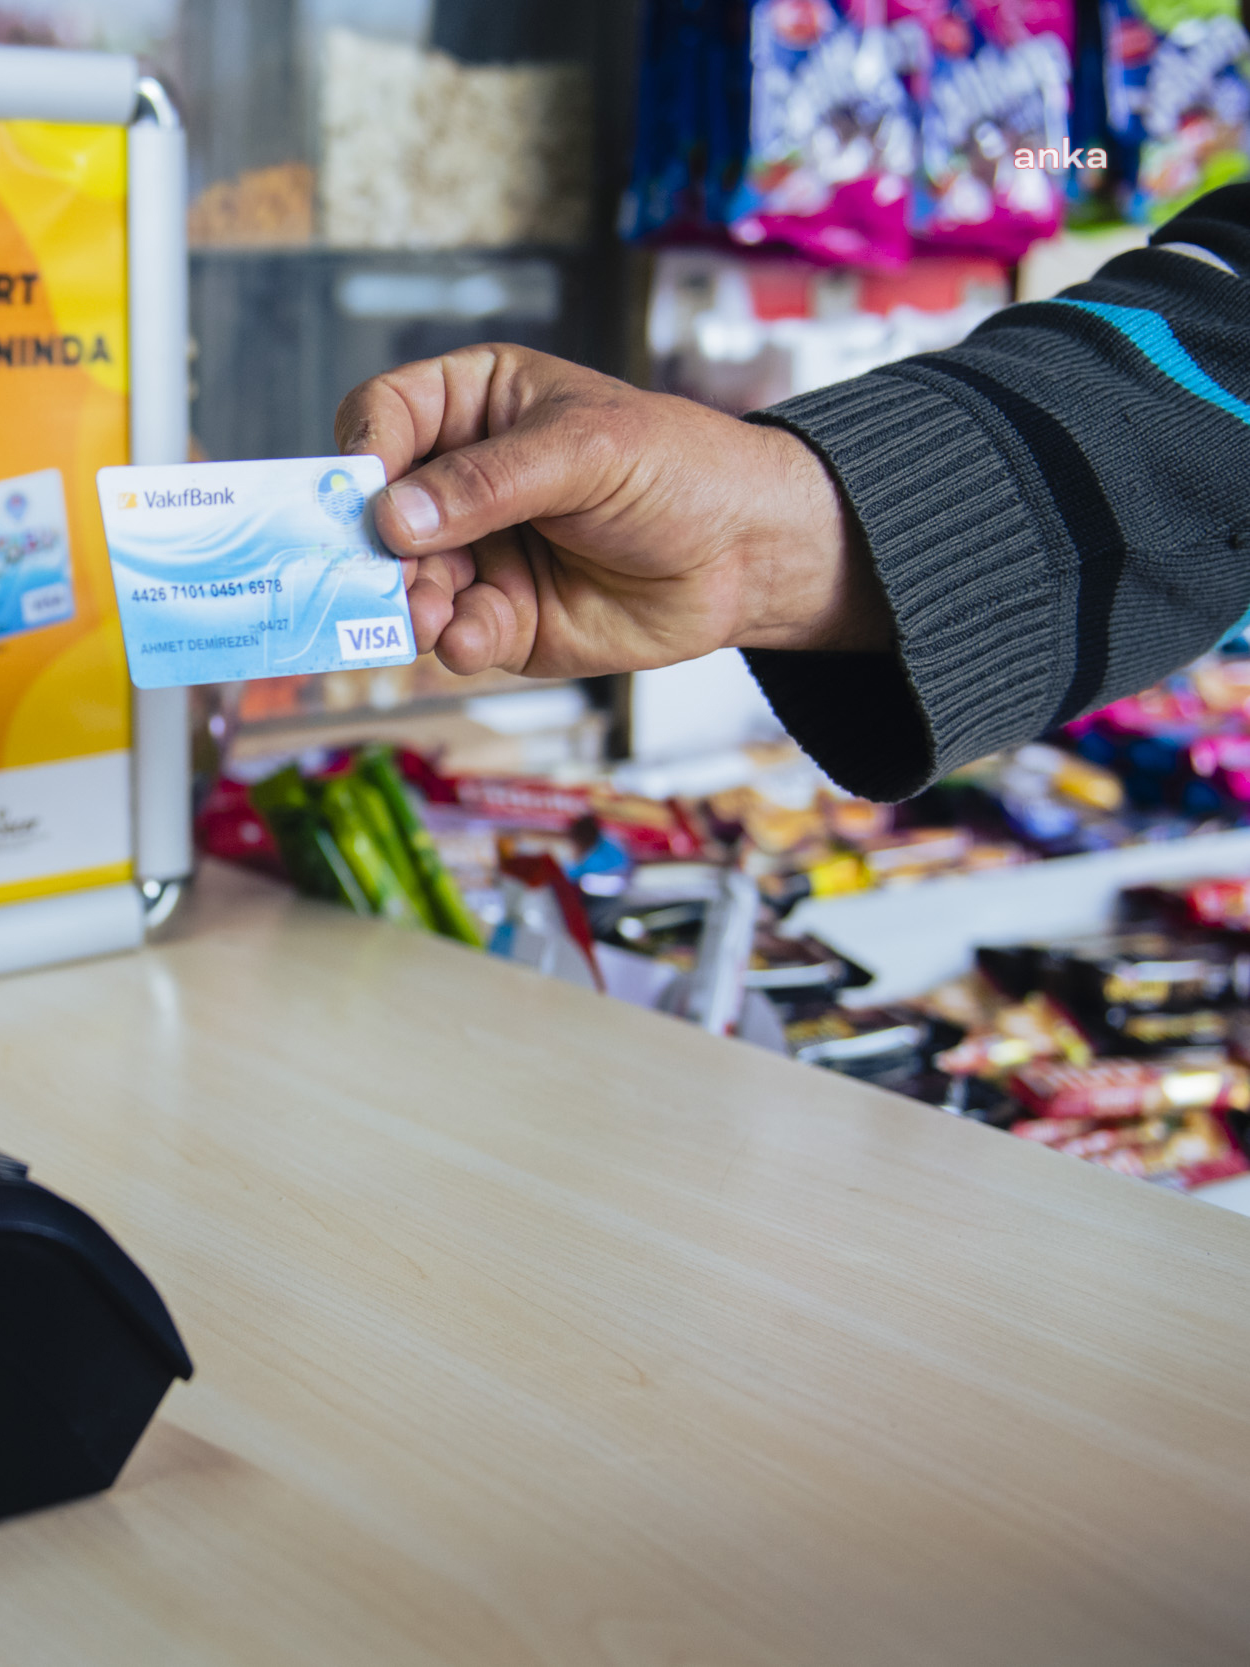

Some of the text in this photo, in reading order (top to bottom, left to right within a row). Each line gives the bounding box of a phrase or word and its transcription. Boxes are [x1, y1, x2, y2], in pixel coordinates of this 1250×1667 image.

[132, 579, 283, 602] 4426 7101 0451 6978
[258, 618, 289, 632] 04/27
[141, 639, 184, 655] AHMET
[343, 625, 402, 651] VISA
